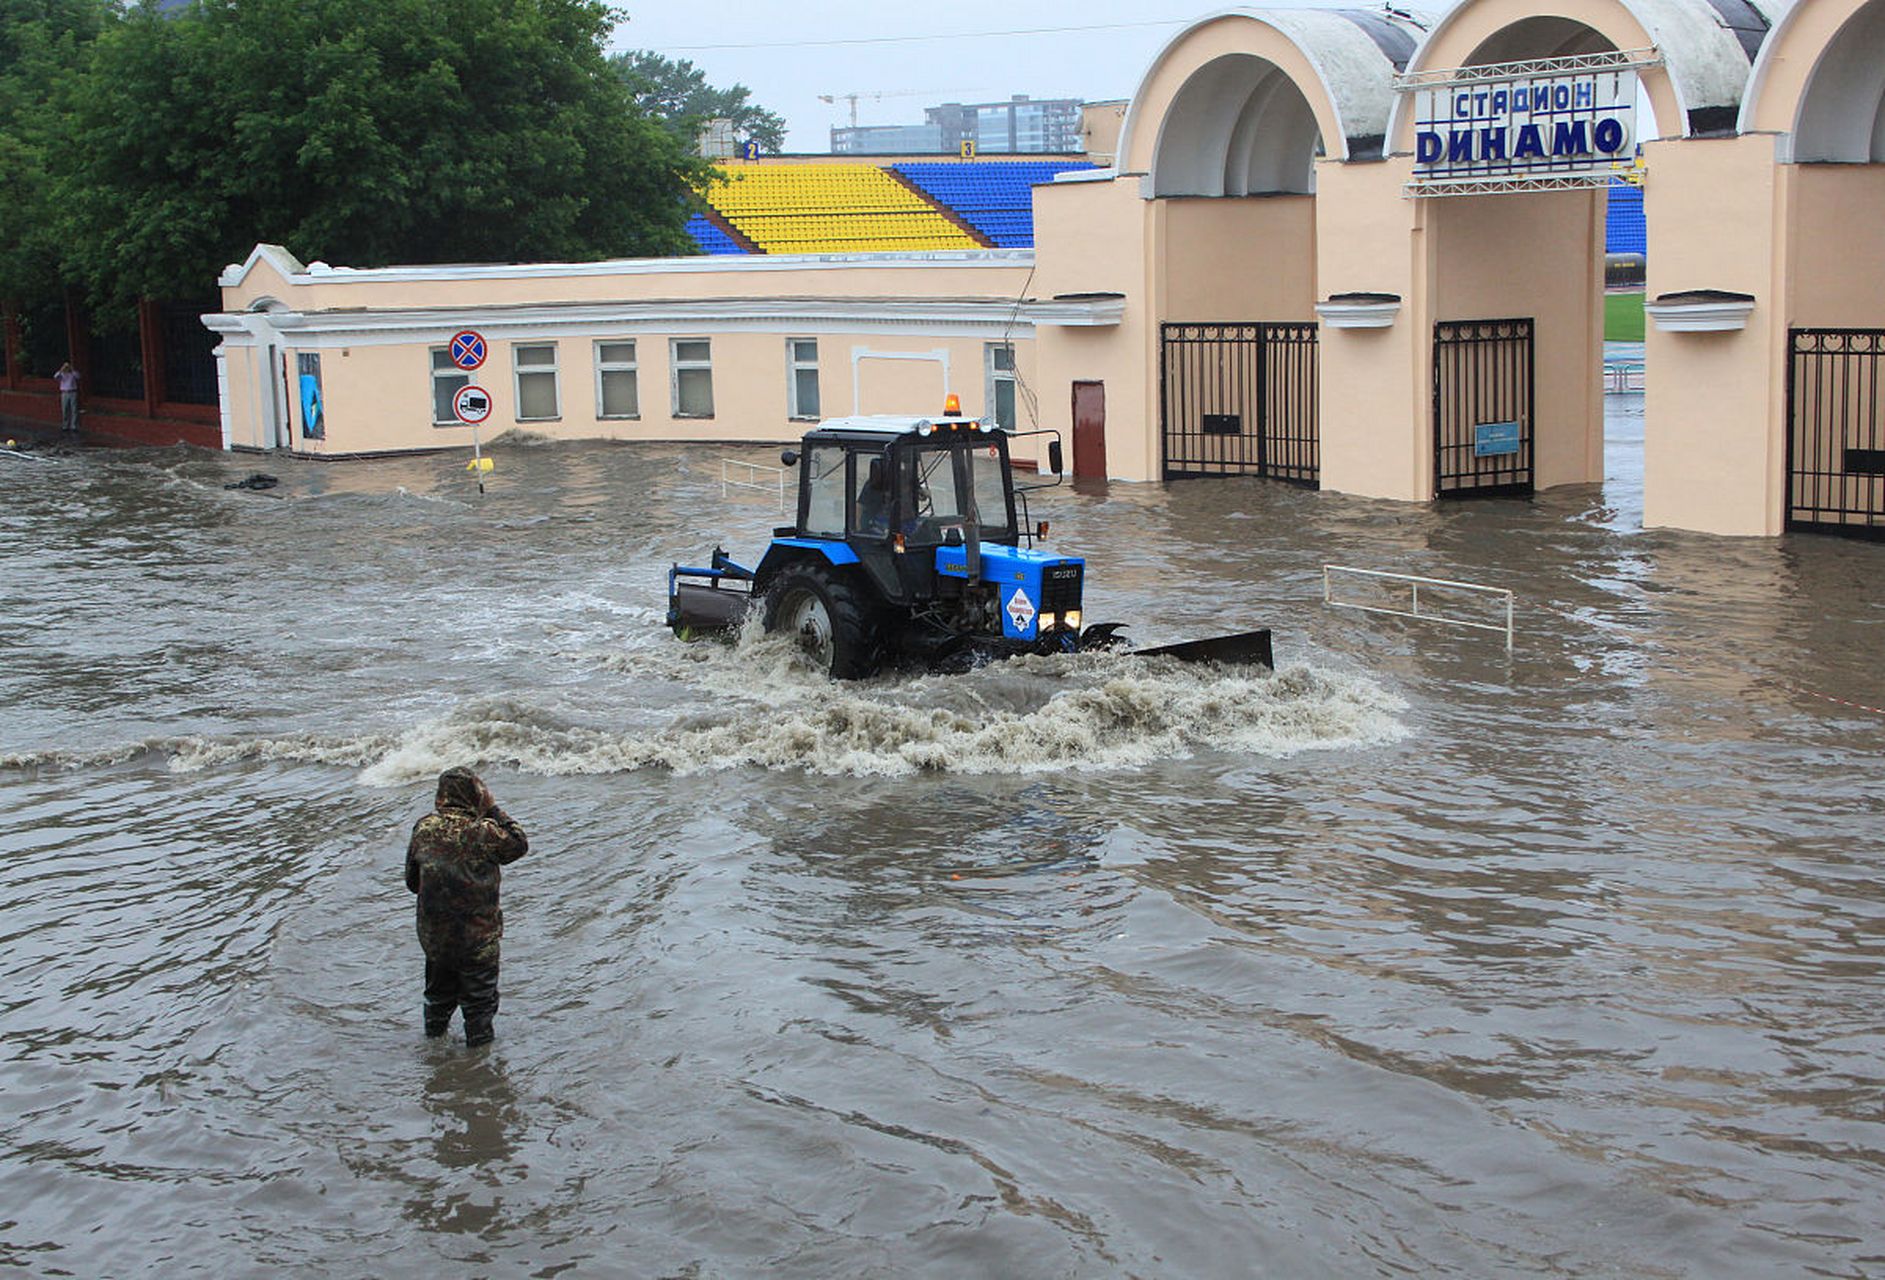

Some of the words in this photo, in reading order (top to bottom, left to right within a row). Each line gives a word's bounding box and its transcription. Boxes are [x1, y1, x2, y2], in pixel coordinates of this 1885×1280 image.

[1455, 82, 1592, 118] СТАДИОН
[748, 143, 757, 159] 2
[964, 142, 972, 156] 3
